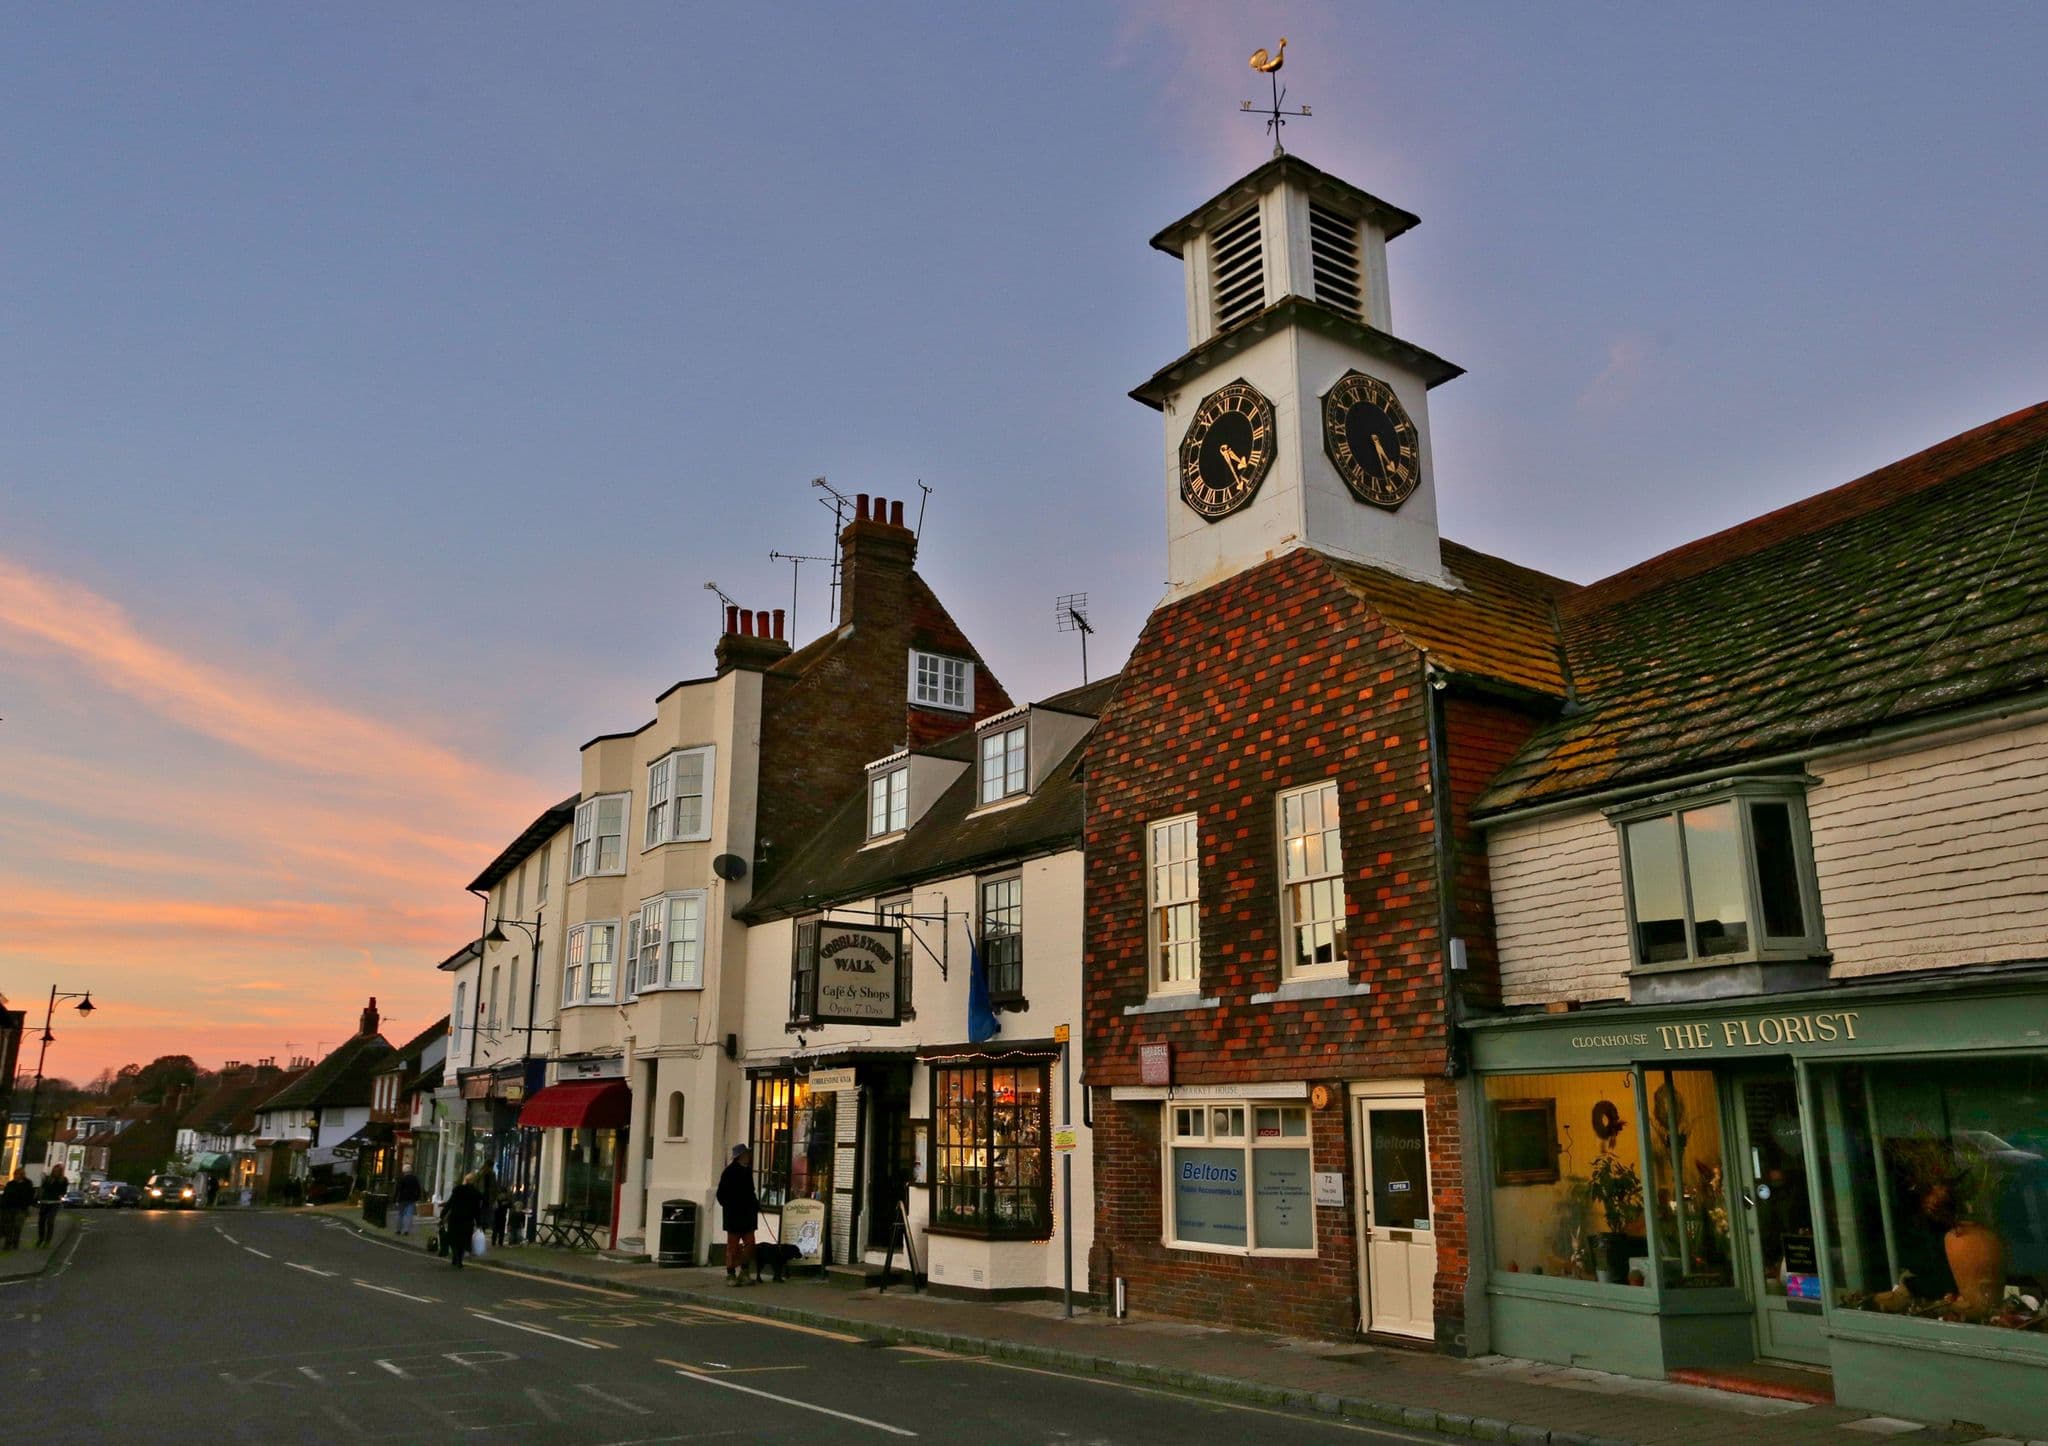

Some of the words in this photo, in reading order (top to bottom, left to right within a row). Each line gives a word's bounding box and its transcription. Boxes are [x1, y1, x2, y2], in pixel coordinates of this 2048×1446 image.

[1247, 406, 1259, 421] II
[1252, 426, 1264, 440] III
[820, 934, 894, 965] COBBLESTONE
[834, 958, 876, 973] WALK
[846, 984, 858, 999] &
[860, 986, 890, 1002] Shops
[829, 1002, 852, 1014] Open
[855, 1003, 863, 1015] 7
[1572, 1034, 1649, 1048] CLOCKHOUSE
[1656, 1023, 1713, 1050] THE
[1721, 1012, 1859, 1047] FLORIST
[1375, 1136, 1422, 1150] Beltons
[1183, 1162, 1238, 1182] Beltons
[1325, 1175, 1333, 1184] 72
